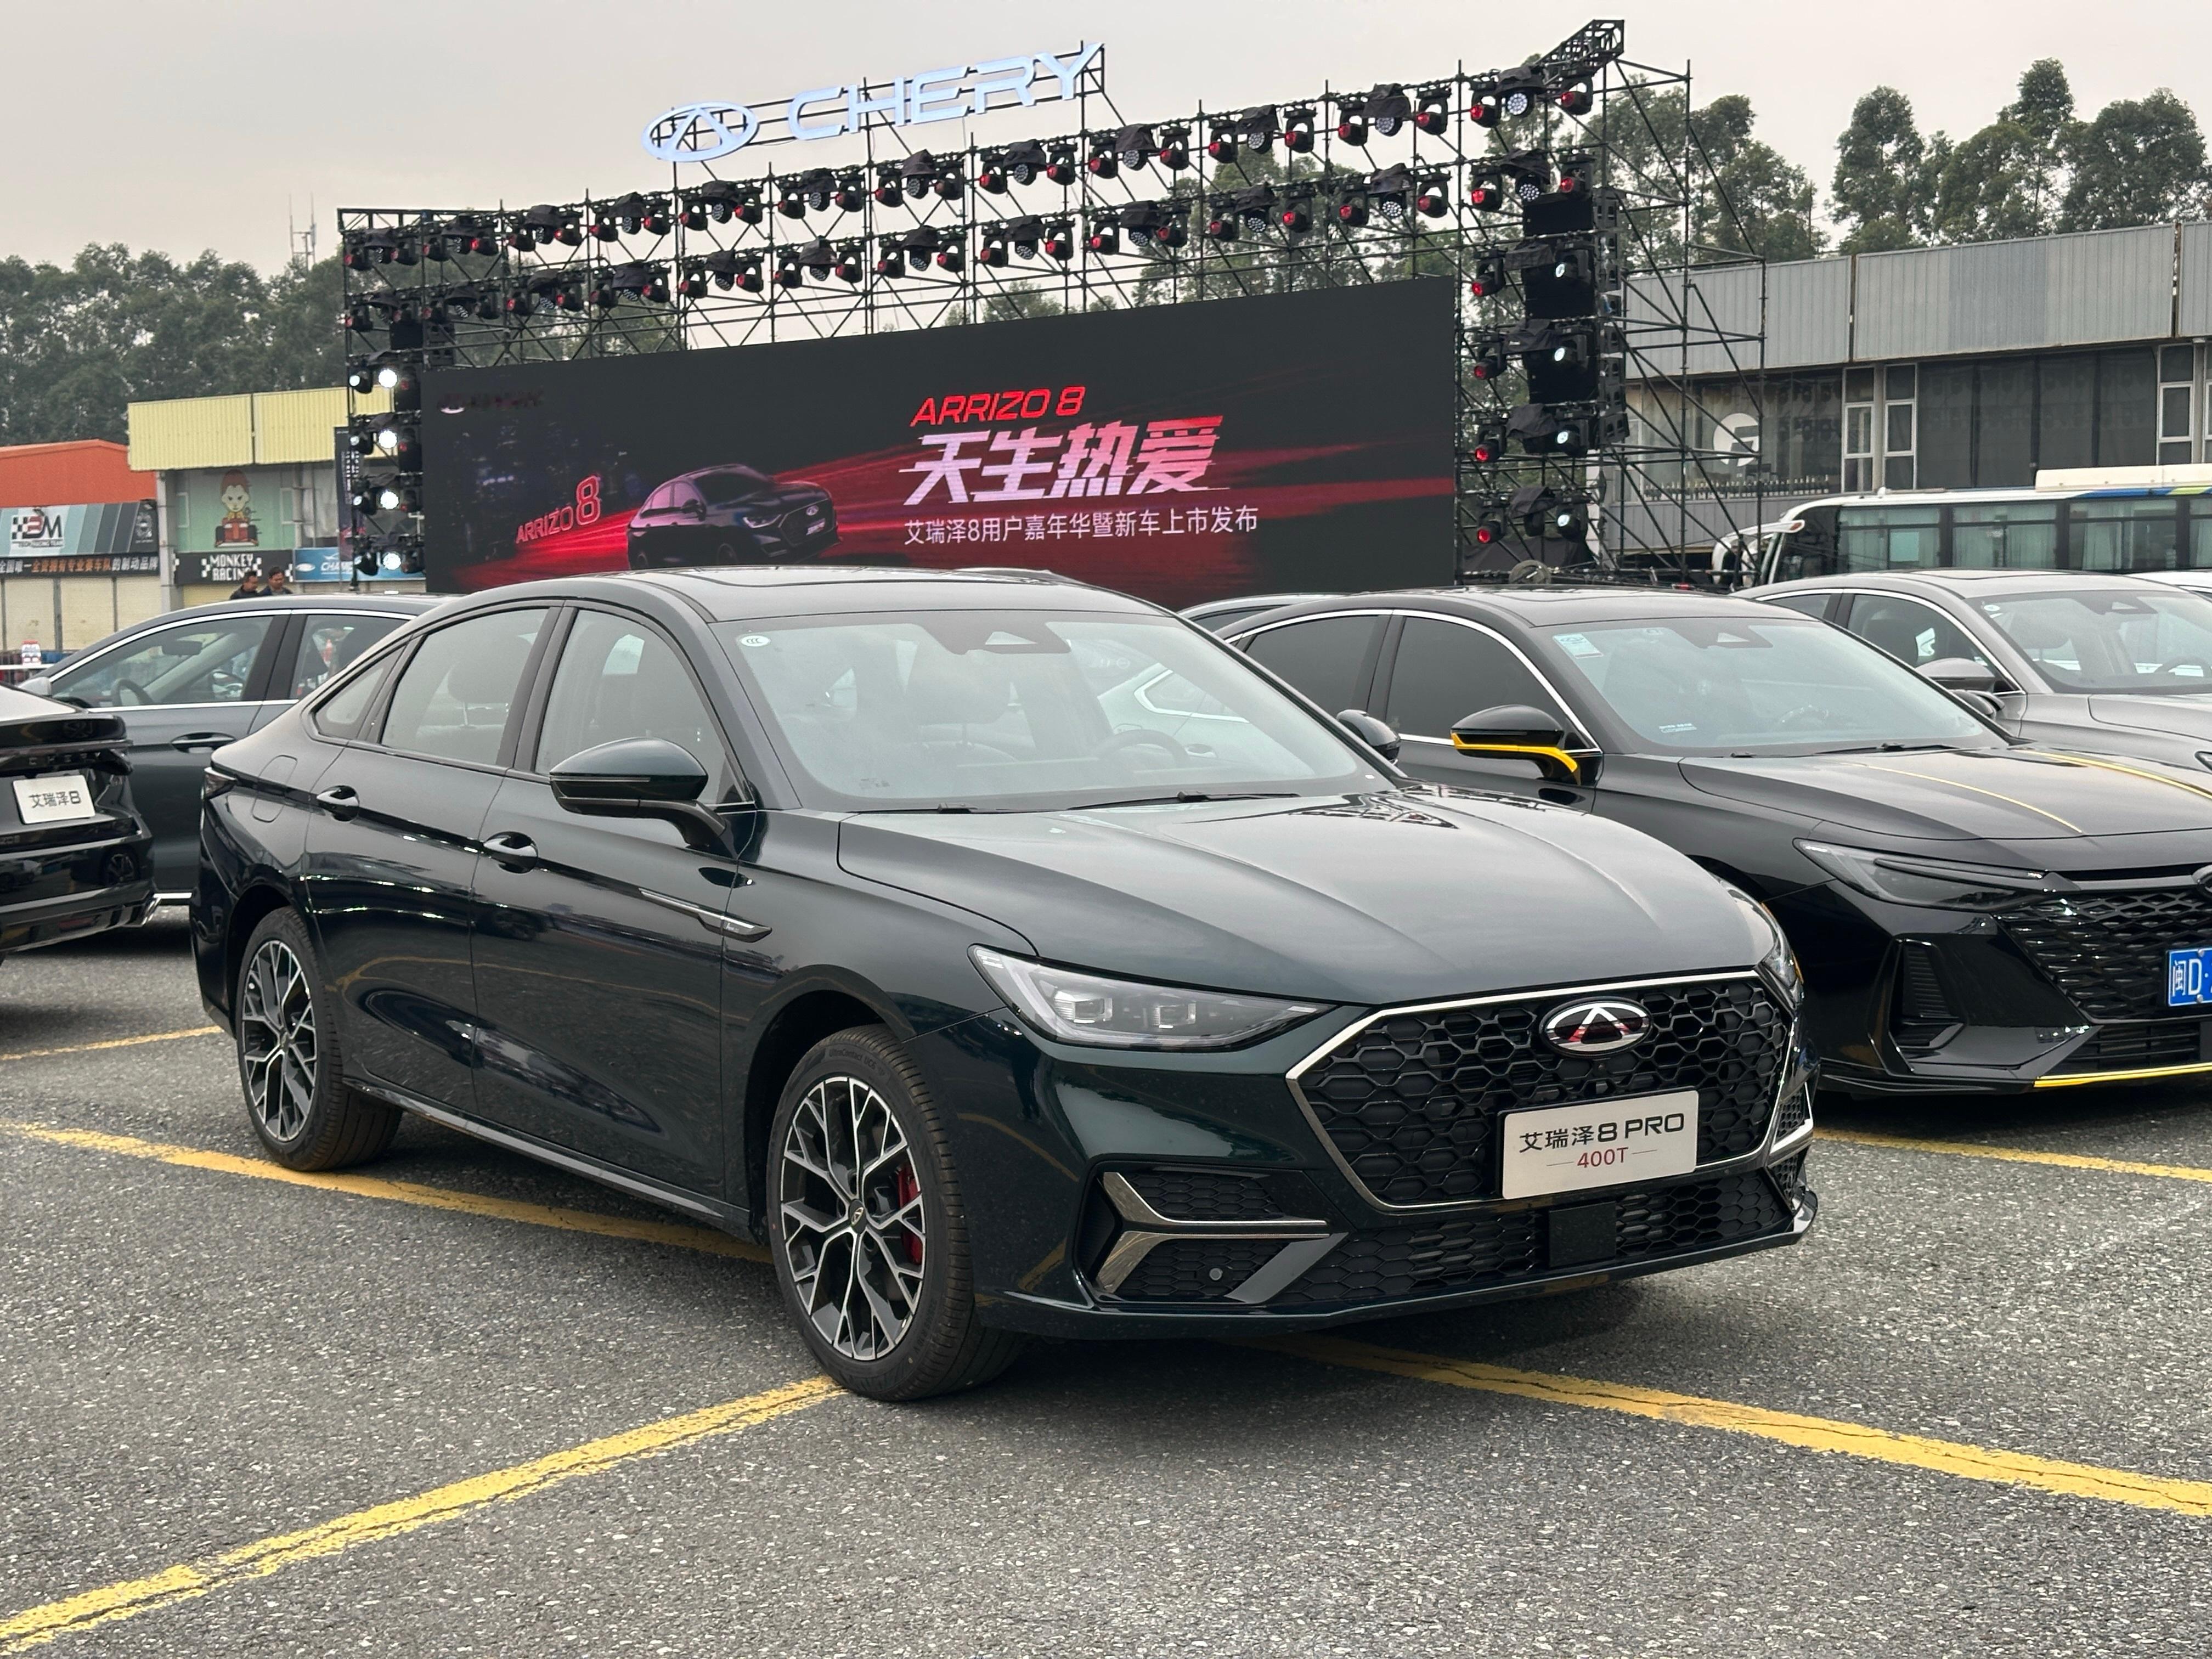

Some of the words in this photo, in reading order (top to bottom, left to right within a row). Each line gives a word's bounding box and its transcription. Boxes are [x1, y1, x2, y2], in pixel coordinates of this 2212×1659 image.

[788, 43, 1103, 140] CHERY
[910, 390, 1052, 426] ARRIZO
[1056, 386, 1086, 415] 8
[899, 415, 1230, 506] 天生热爱
[516, 506, 574, 544] ARRIZO
[577, 475, 601, 525] 8
[903, 505, 1260, 545] 艾瑞泽8用户嘉年华暨新车上市发布
[210, 553, 253, 567] MONKEY
[29, 790, 82, 809] 艾瑞泽8
[1519, 1122, 1617, 1153] 艾瑞泽8
[1624, 1113, 1684, 1139] PRO
[1577, 1148, 1628, 1169] 400T
